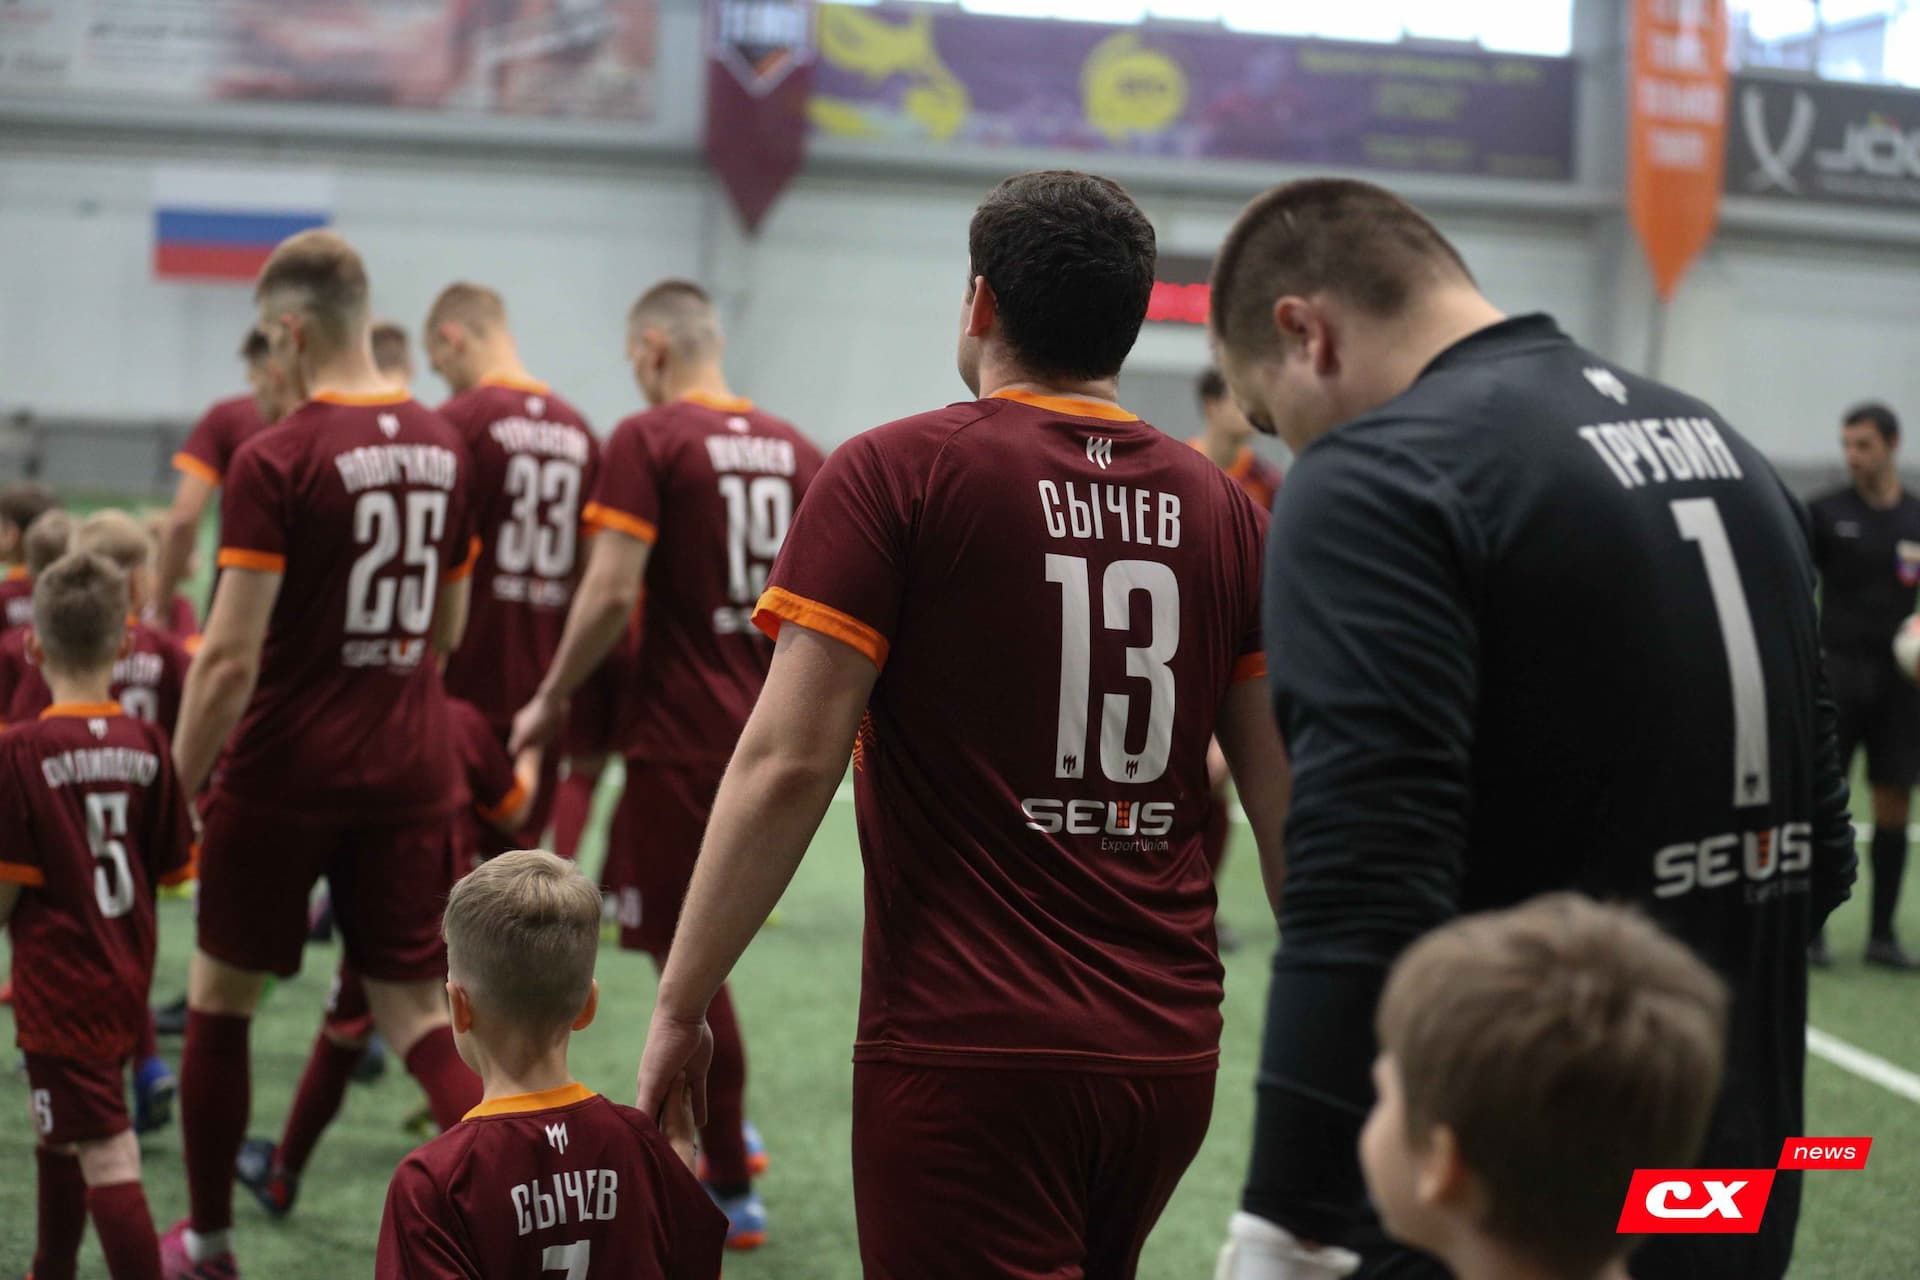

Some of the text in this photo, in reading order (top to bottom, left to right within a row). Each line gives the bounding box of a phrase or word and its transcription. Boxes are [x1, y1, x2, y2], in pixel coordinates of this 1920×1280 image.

[1578, 417, 1744, 489] ТРУБИН
[345, 491, 449, 634] 25
[496, 454, 582, 577] 33
[1038, 479, 1181, 548] СЫЧЕВ
[1044, 552, 1180, 784] 13
[1669, 497, 1770, 808] 1
[85, 791, 135, 919] 5
[1020, 798, 1176, 837] SEUS
[1653, 822, 1812, 899] SEUS
[510, 1169, 618, 1236] СЫЧЕВ
